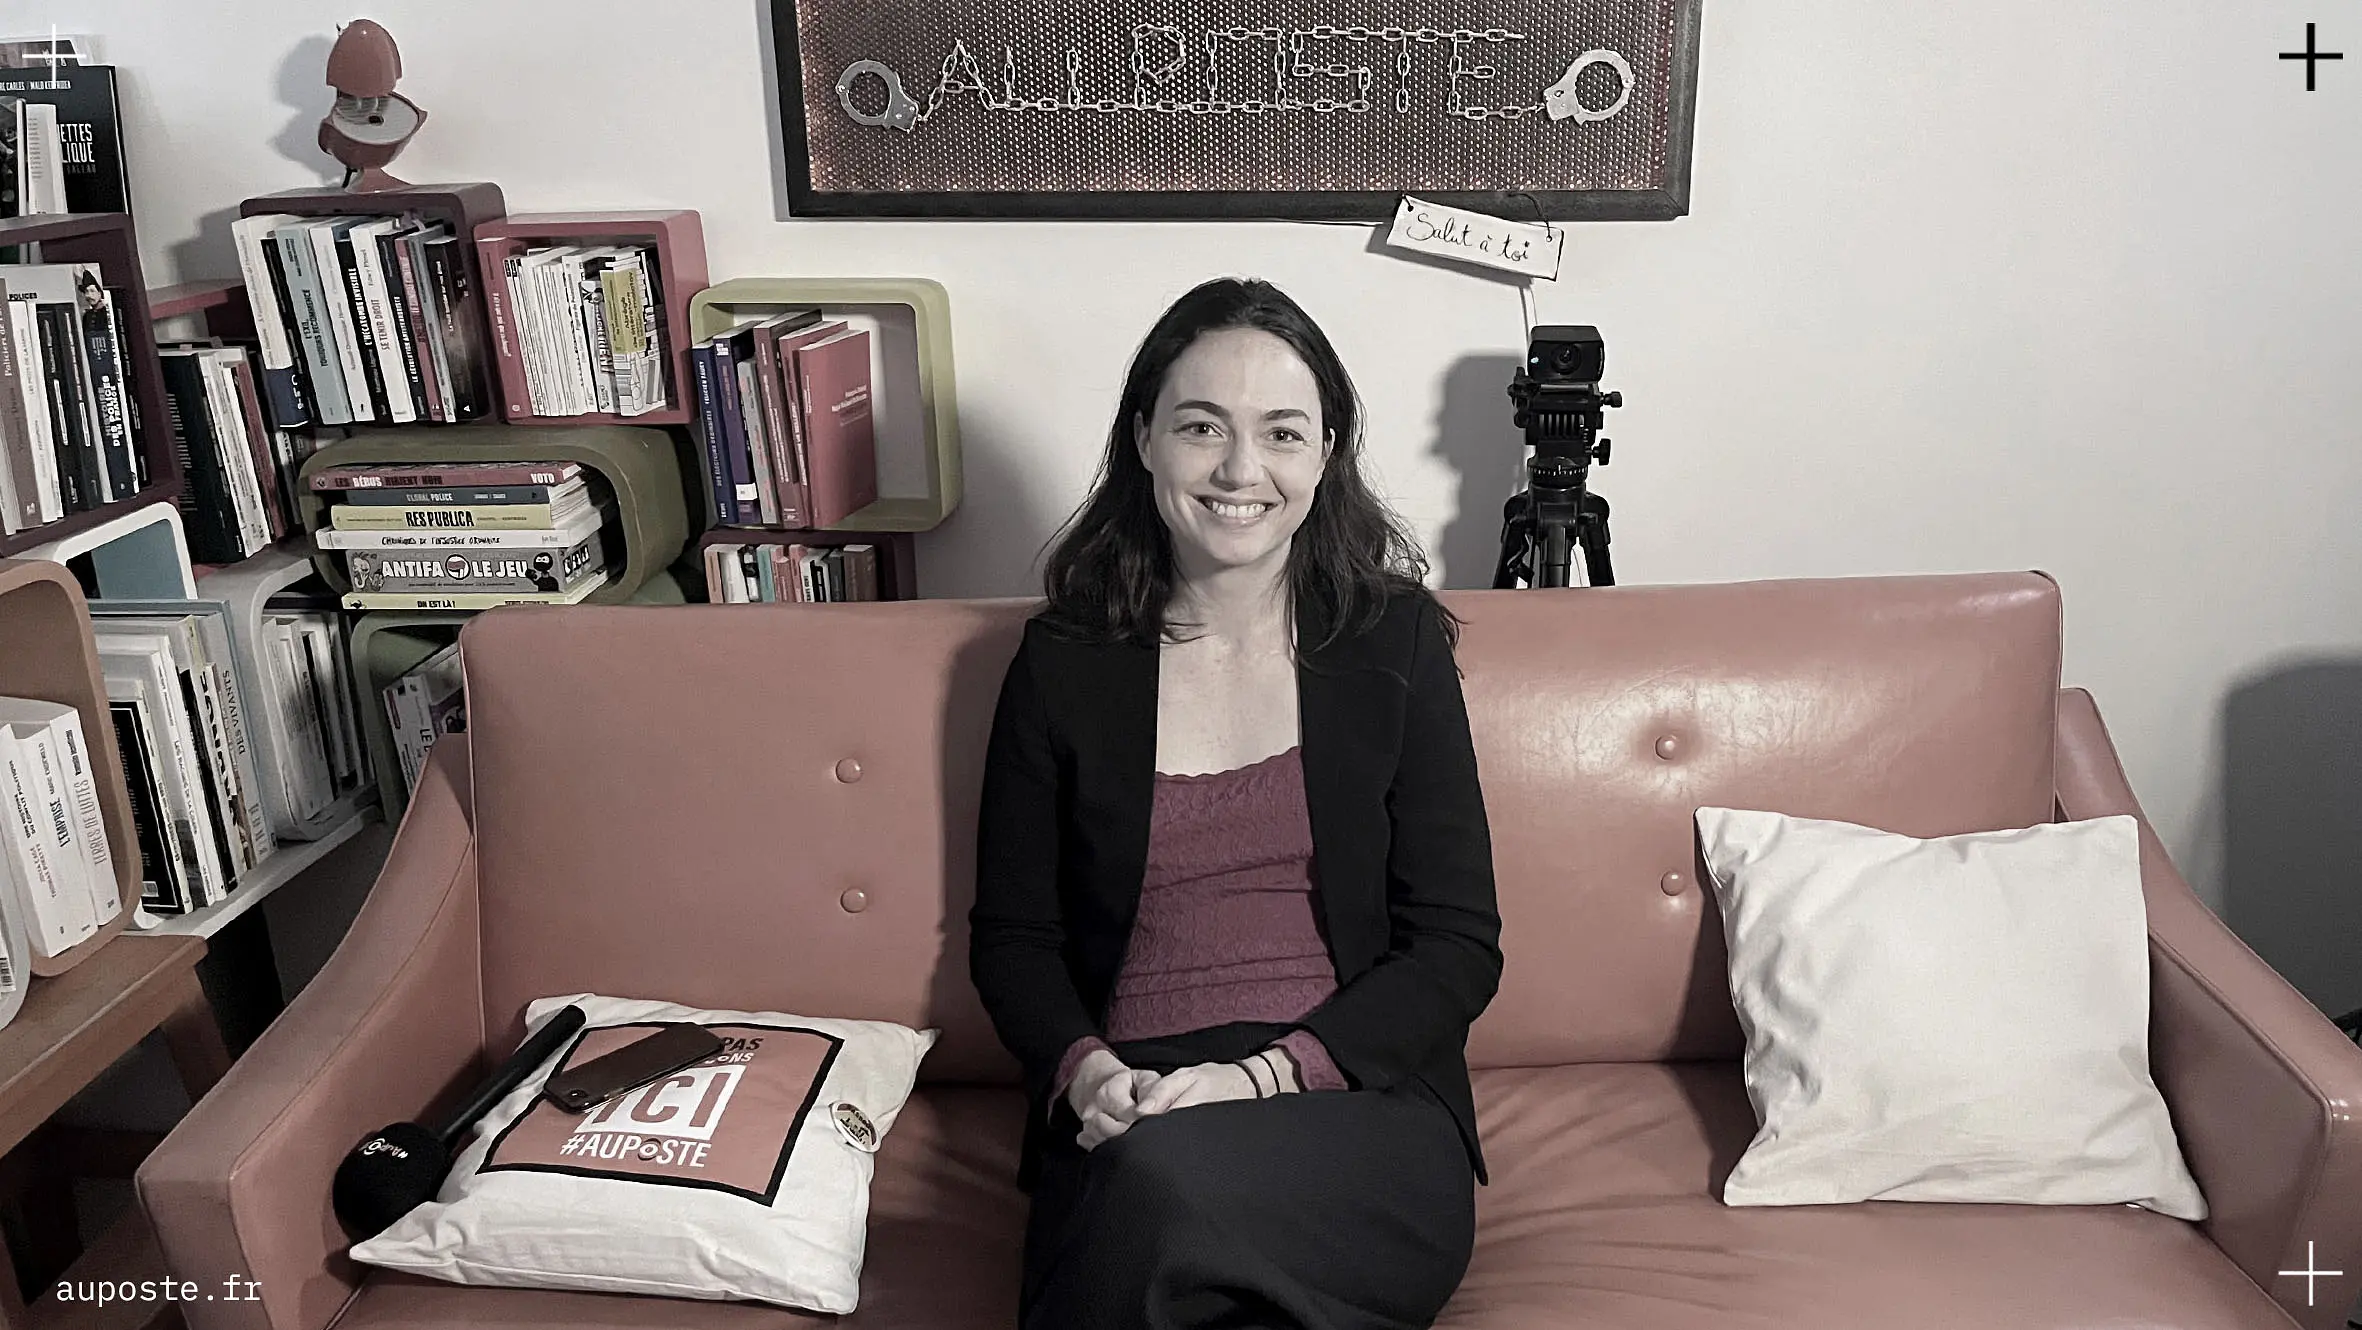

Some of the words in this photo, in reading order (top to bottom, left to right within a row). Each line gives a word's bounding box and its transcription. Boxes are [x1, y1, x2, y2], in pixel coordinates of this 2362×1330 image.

[1406, 213, 1472, 247] Salut
[1479, 236, 1494, 252] à
[1499, 234, 1530, 262] toi
[348, 267, 362, 301] INVISIBLE
[370, 298, 383, 320] DROIT
[375, 319, 387, 341] TENIR
[1, 337, 12, 376] Policiers
[380, 341, 390, 351] SE
[98, 386, 113, 436] HISTOIRE
[101, 374, 116, 423] POLICES
[110, 384, 121, 421] FRANCE
[110, 424, 120, 446] DES
[116, 423, 123, 435] EN
[335, 477, 350, 487] LES
[352, 475, 382, 487] BÉRUS
[531, 473, 554, 484] VOTO
[431, 493, 453, 501] POLICE
[406, 512, 426, 527] RES
[427, 511, 474, 527] PUBLICA
[381, 560, 445, 578] ANTIFA
[471, 560, 492, 578] LE
[495, 560, 528, 578] JEU
[221, 668, 240, 727] VIVANTS
[233, 728, 246, 754] DES
[8, 758, 23, 795] POLITIQUE
[19, 795, 32, 824] CONFLIT
[72, 777, 96, 815] LUTTES
[28, 824, 36, 834] DU
[47, 797, 72, 847] L'EMPRISE
[82, 814, 98, 828] DE
[85, 828, 107, 865] TERRES
[719, 1036, 764, 1051] PAS
[560, 1134, 712, 1168] #AUPOSTE
